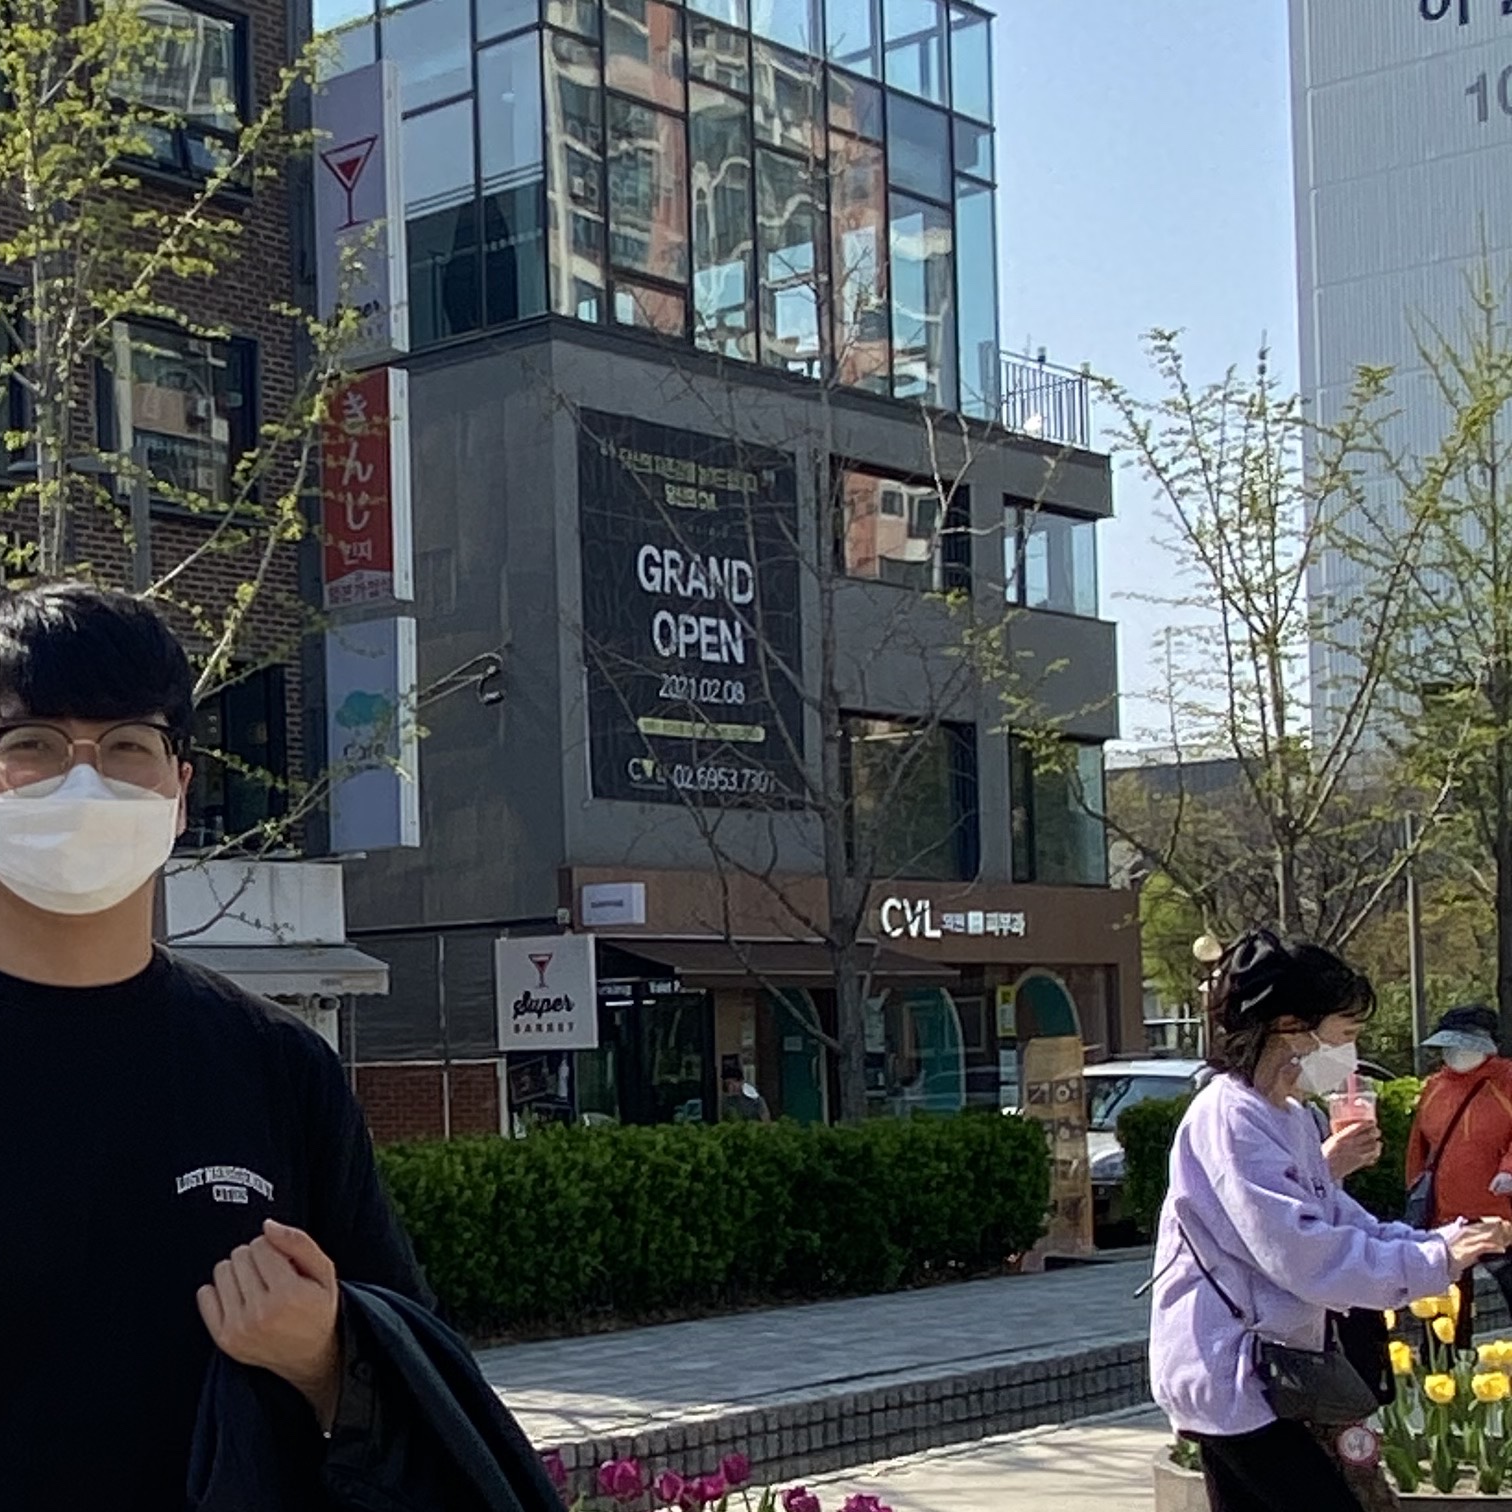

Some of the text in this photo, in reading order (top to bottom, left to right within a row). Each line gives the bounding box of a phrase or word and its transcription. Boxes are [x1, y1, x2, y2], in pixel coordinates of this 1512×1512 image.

[637, 544, 755, 604] GRAND
[652, 610, 745, 664] OPEN
[881, 897, 942, 938] CVL
[513, 991, 575, 1019] Super
